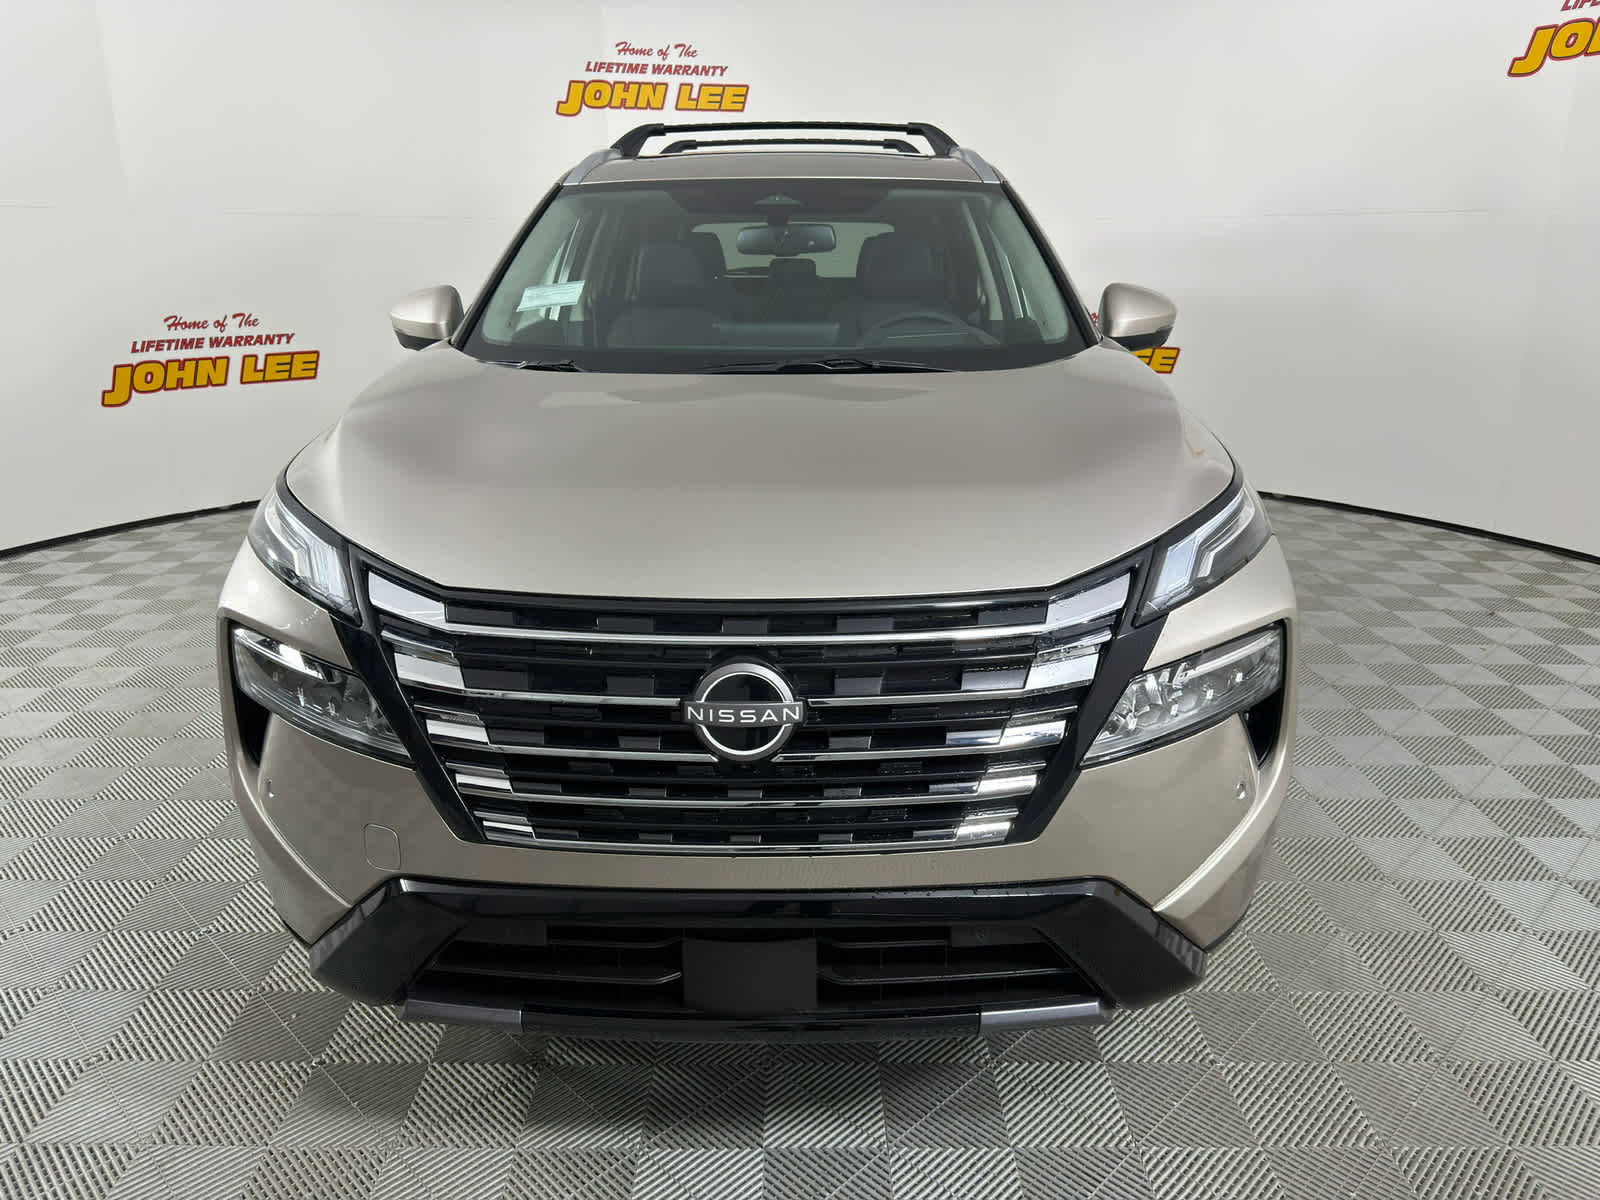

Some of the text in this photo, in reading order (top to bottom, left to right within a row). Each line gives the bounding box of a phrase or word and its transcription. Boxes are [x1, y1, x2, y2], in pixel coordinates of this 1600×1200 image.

[615, 41, 698, 61] Home of The
[585, 61, 728, 76] LIFETIME WARRANTY
[556, 79, 749, 117] JOHN LEE
[163, 313, 259, 332] Home of The
[131, 333, 294, 353] LIFETIME WARRANTY
[101, 350, 320, 407] JOHN LEE
[687, 706, 800, 722] NISSAN
